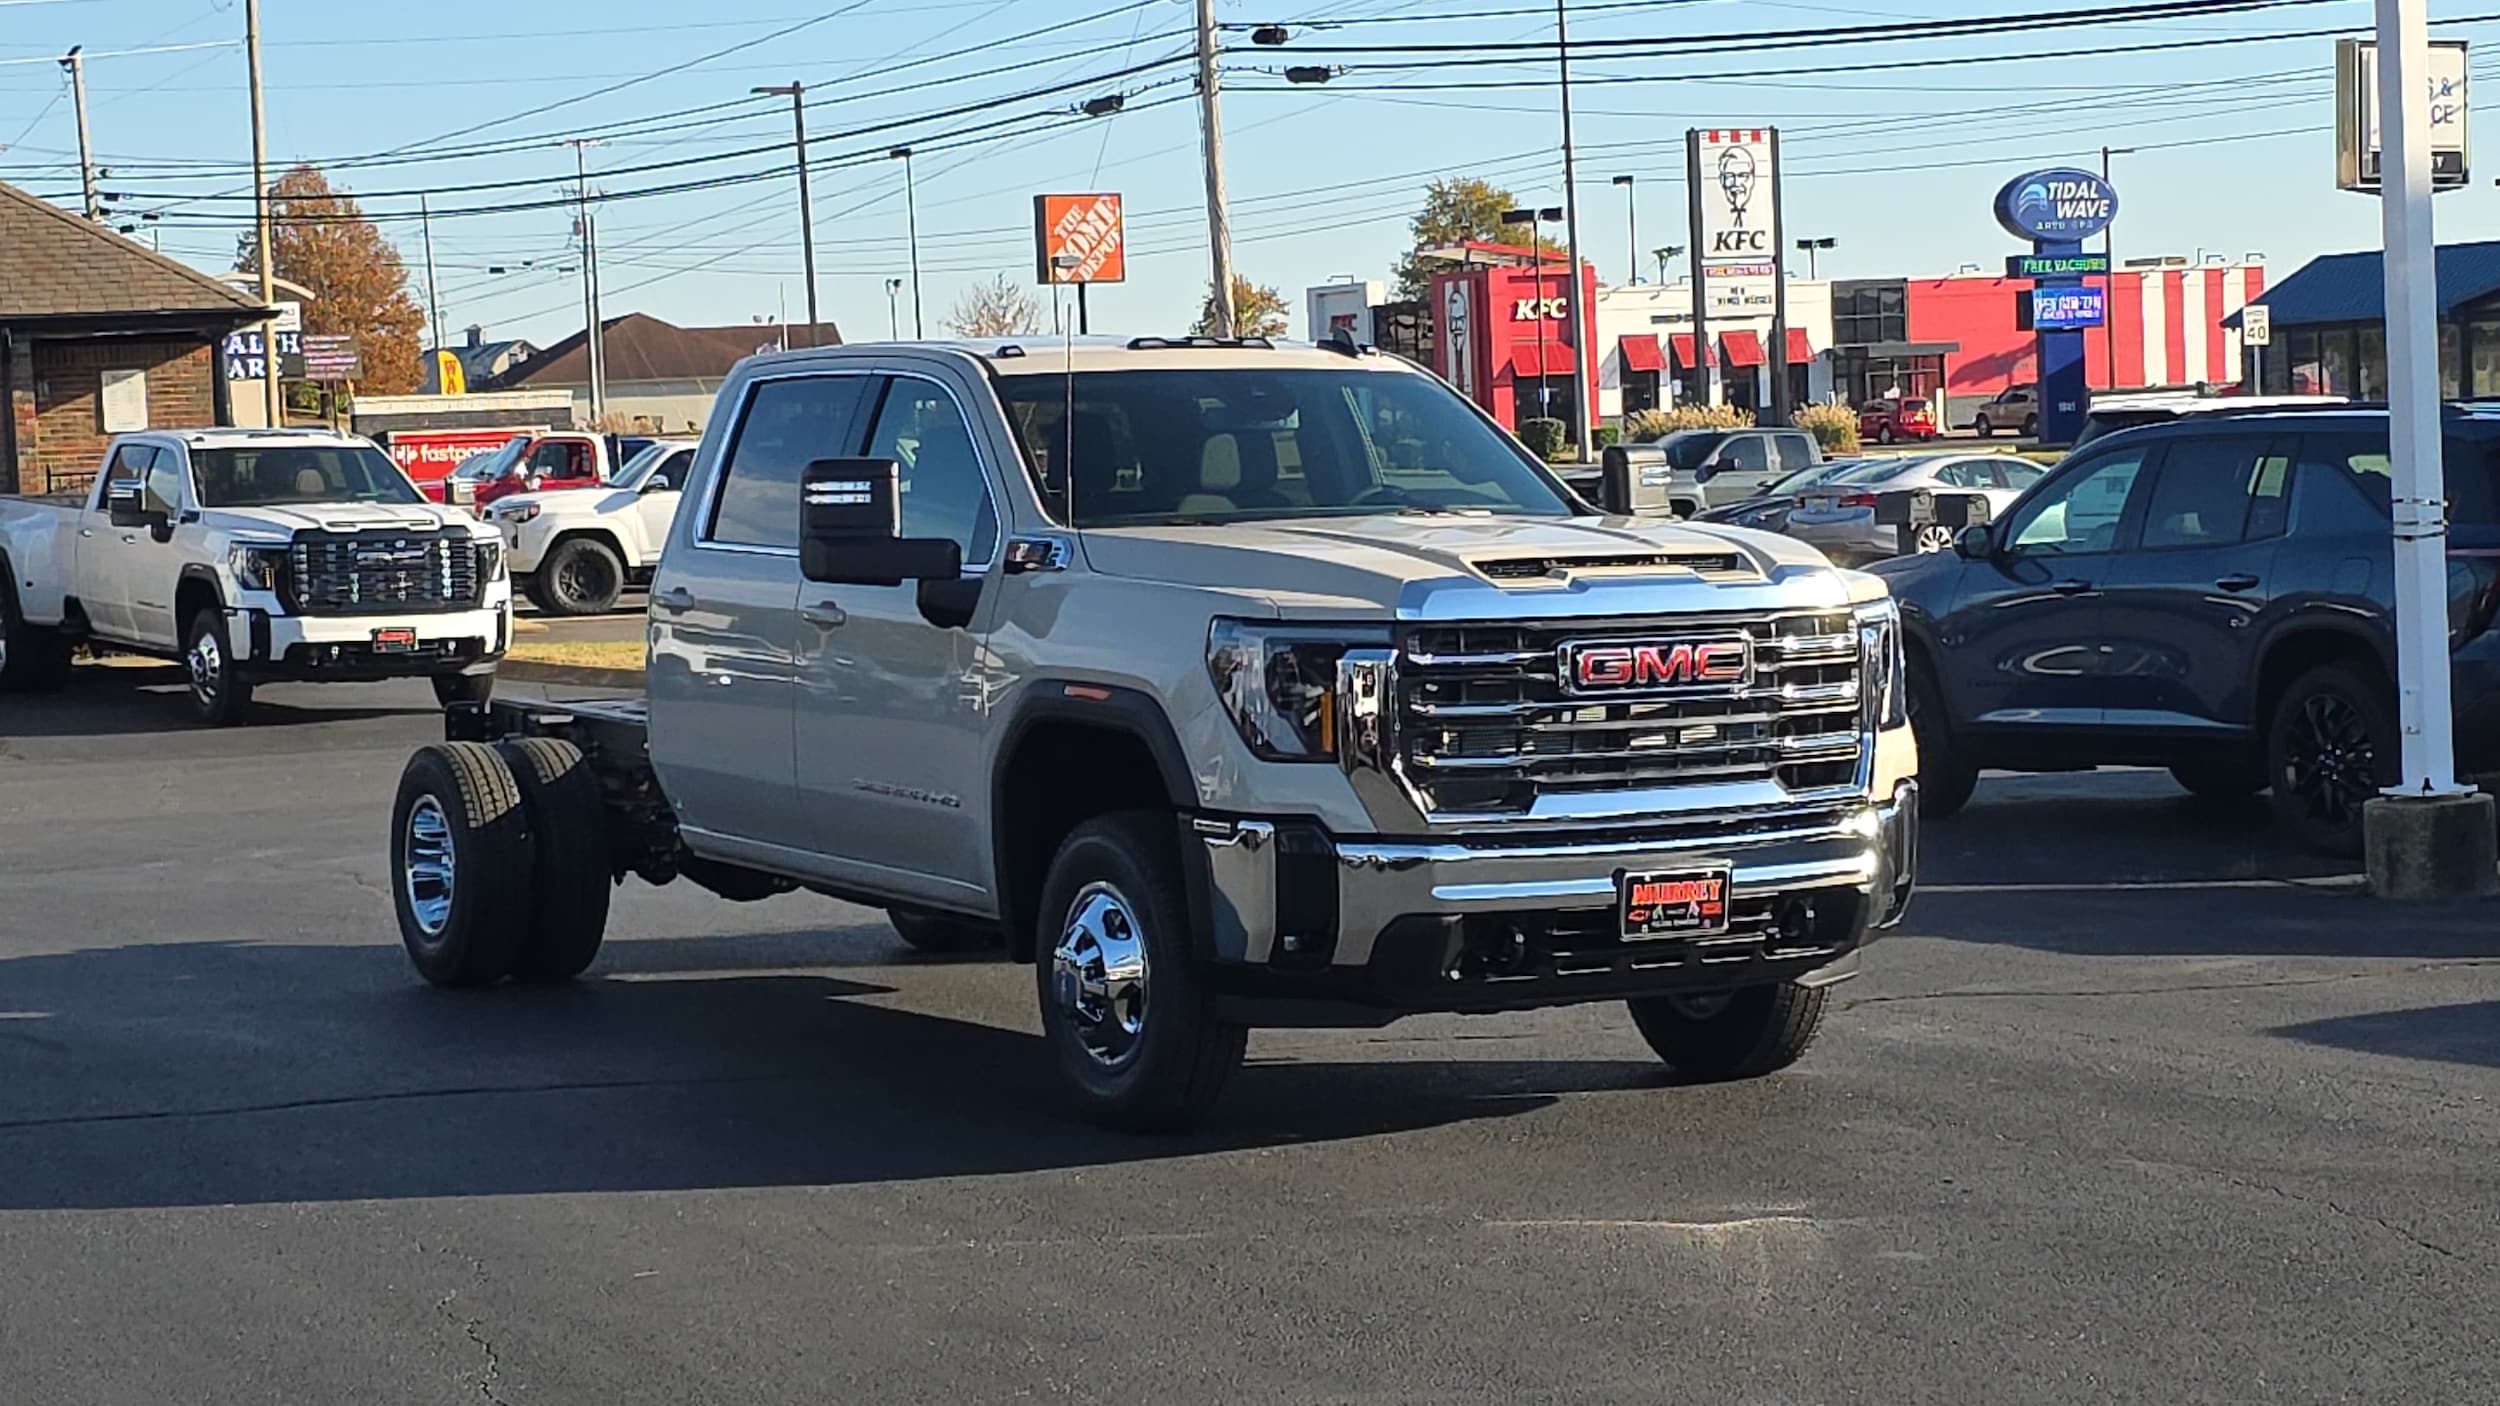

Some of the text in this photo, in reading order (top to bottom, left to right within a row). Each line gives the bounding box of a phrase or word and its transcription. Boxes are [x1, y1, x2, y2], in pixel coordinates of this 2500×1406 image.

[2048, 181, 2099, 200] TIDAL
[2056, 199, 2110, 219] WAVE
[1713, 229, 1767, 252] KFC
[1515, 297, 1568, 320] KFC
[2247, 325, 2266, 340] 40
[225, 334, 301, 354] ALH
[1580, 643, 1743, 686] GMC
